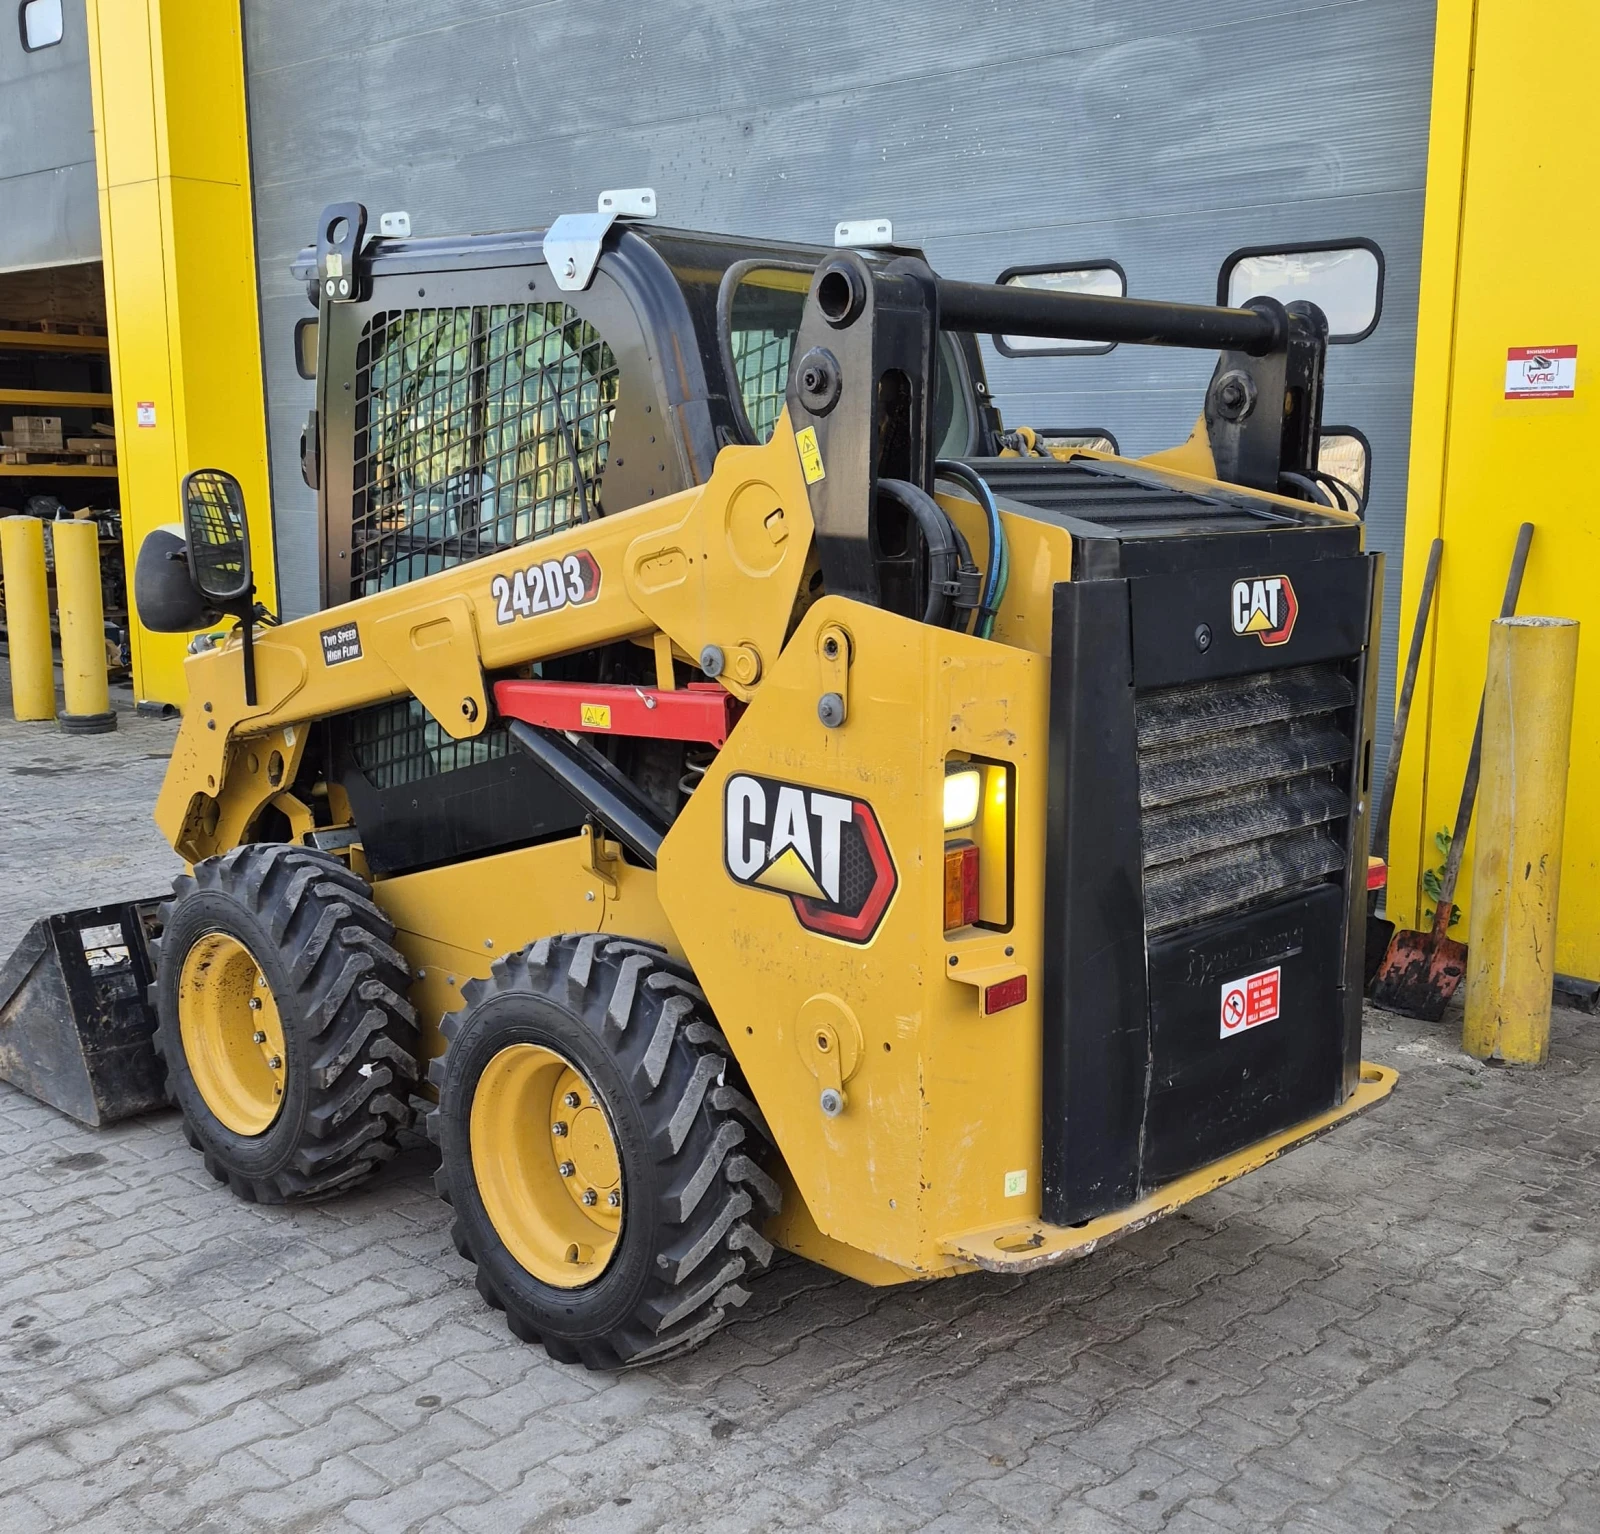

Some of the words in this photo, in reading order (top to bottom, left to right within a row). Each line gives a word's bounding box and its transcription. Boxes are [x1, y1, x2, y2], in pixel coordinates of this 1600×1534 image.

[1527, 373, 1555, 384] VAG
[492, 555, 585, 622] 242D3
[1233, 578, 1281, 633] CAT
[727, 776, 853, 904] CAT
